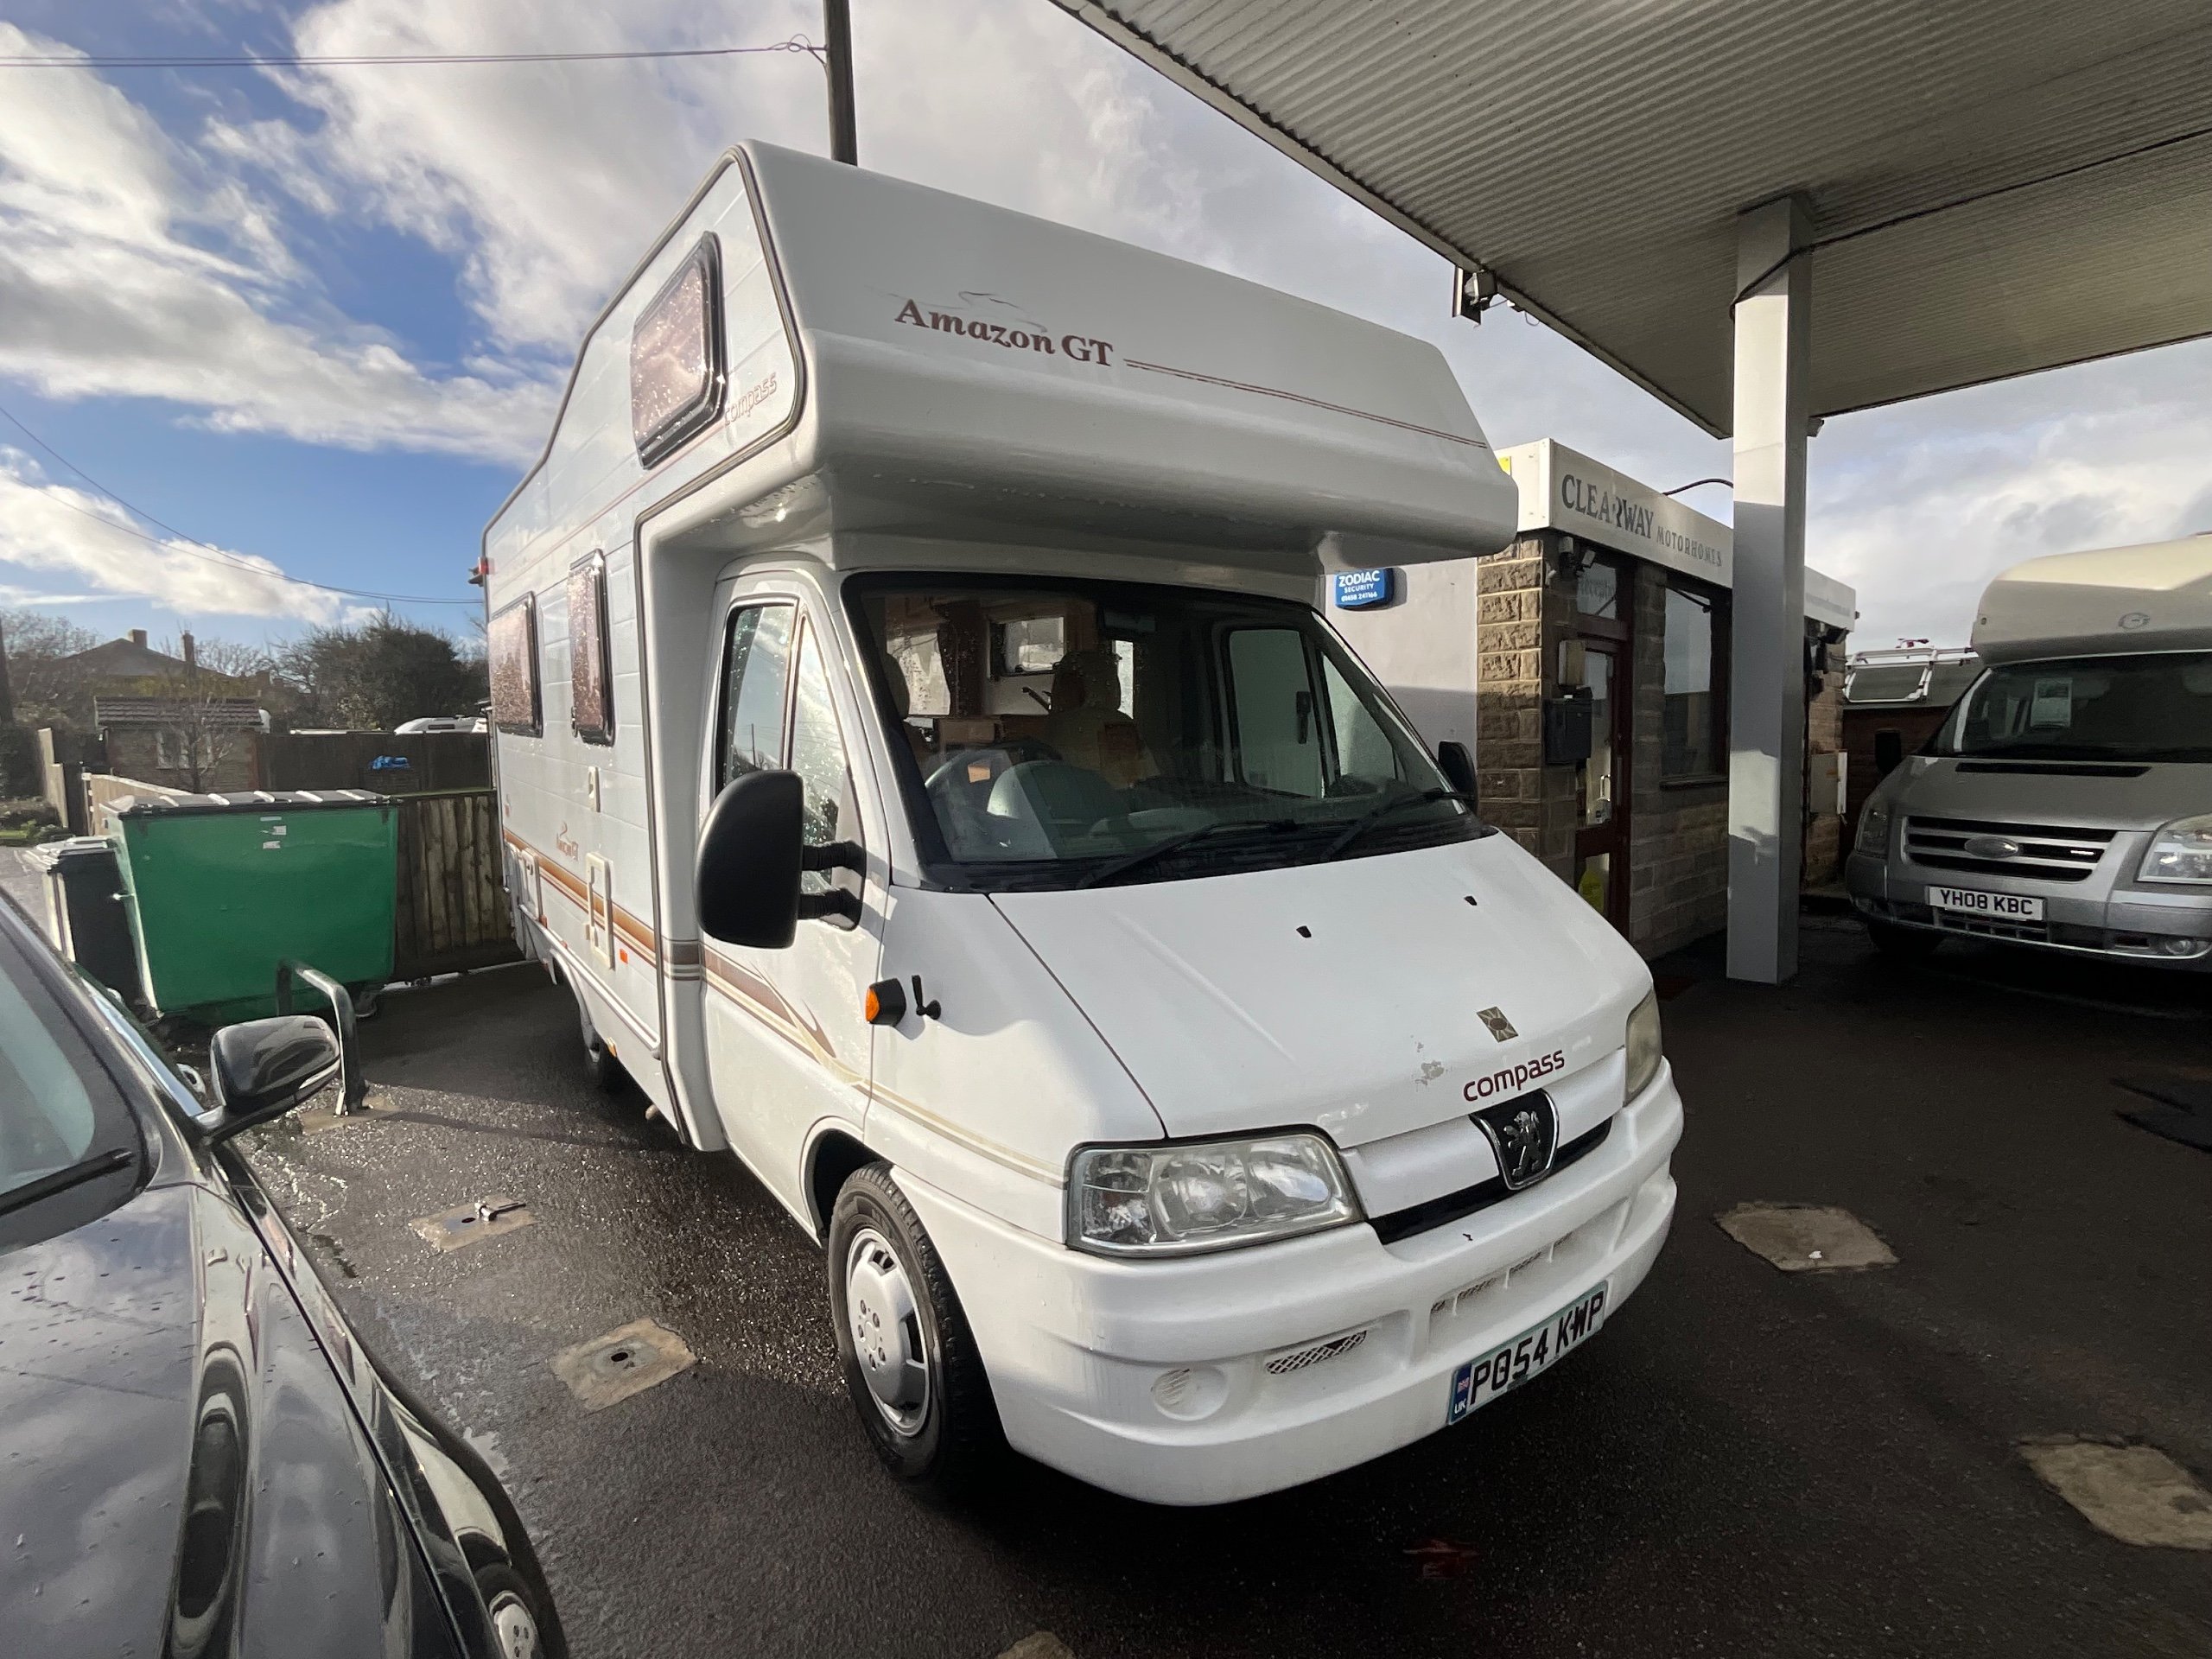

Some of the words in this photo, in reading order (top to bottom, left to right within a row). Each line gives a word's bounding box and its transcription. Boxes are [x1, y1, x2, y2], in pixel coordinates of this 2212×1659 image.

[894, 298, 1056, 354] Amazon
[1061, 334, 1114, 366] GT
[1656, 525, 1723, 567] MOTORHOMES
[1338, 570, 1381, 588] ZODIAC
[1344, 582, 1375, 594] SECURITY
[1940, 889, 1988, 909] YH08
[1993, 896, 2033, 915] KBC
[1463, 1050, 1565, 1102] compass
[1555, 1290, 1605, 1354] KWP
